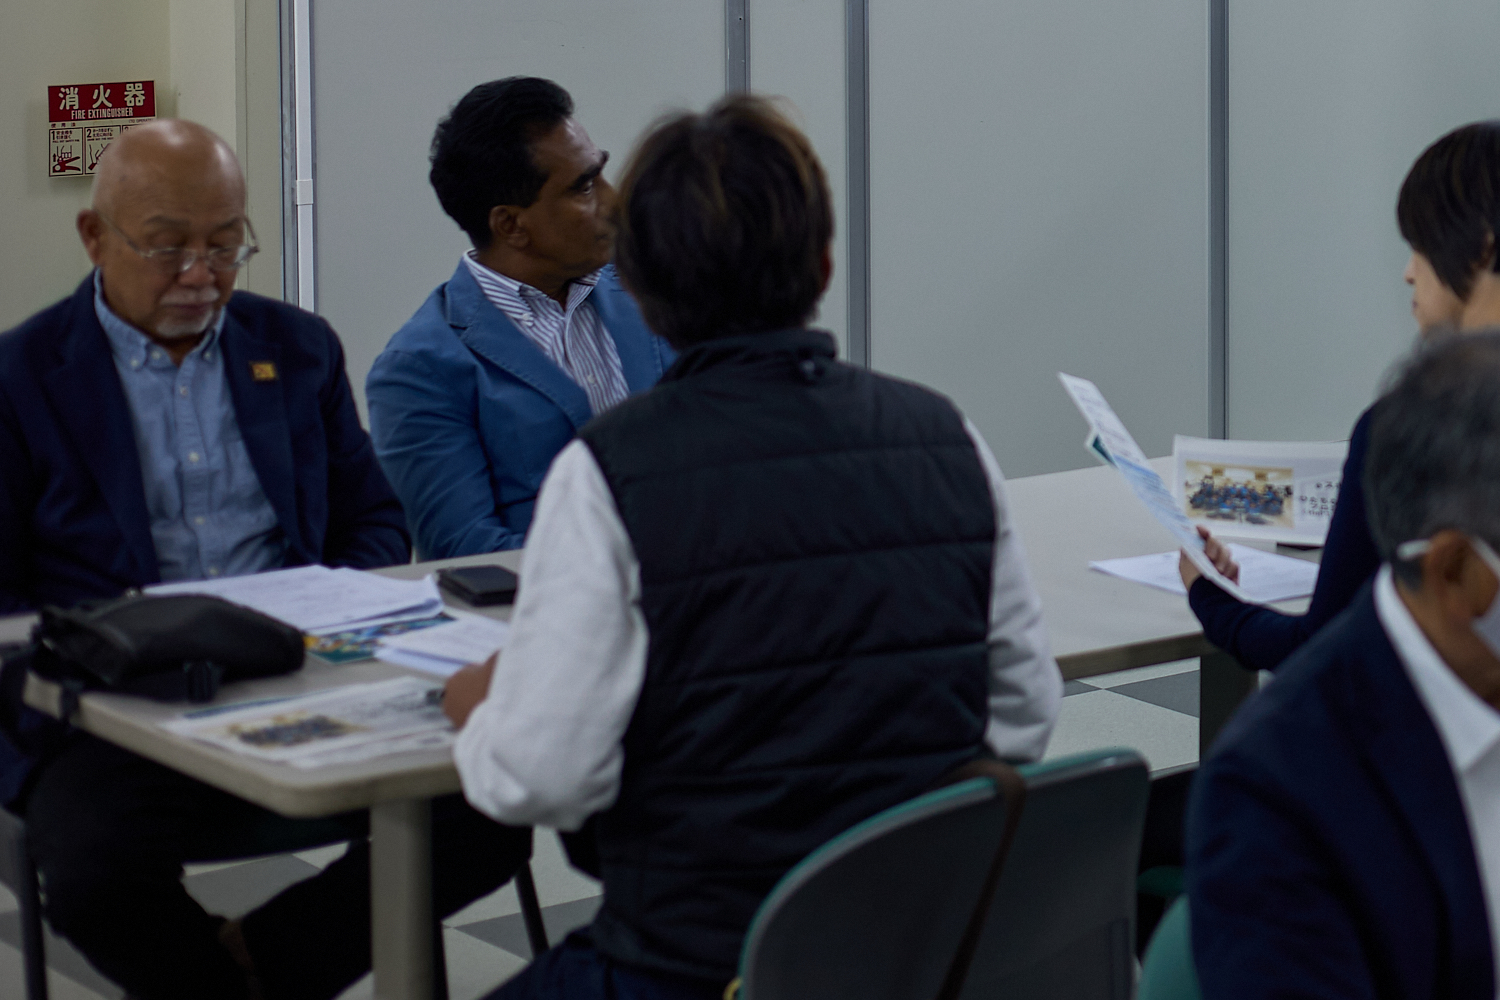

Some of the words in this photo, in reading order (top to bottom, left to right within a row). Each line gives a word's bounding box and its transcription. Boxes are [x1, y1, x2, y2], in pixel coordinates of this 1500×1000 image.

[59, 83, 145, 110] 消火器
[71, 109, 86, 120] FIRE
[88, 108, 133, 119] EXTINGUISHER
